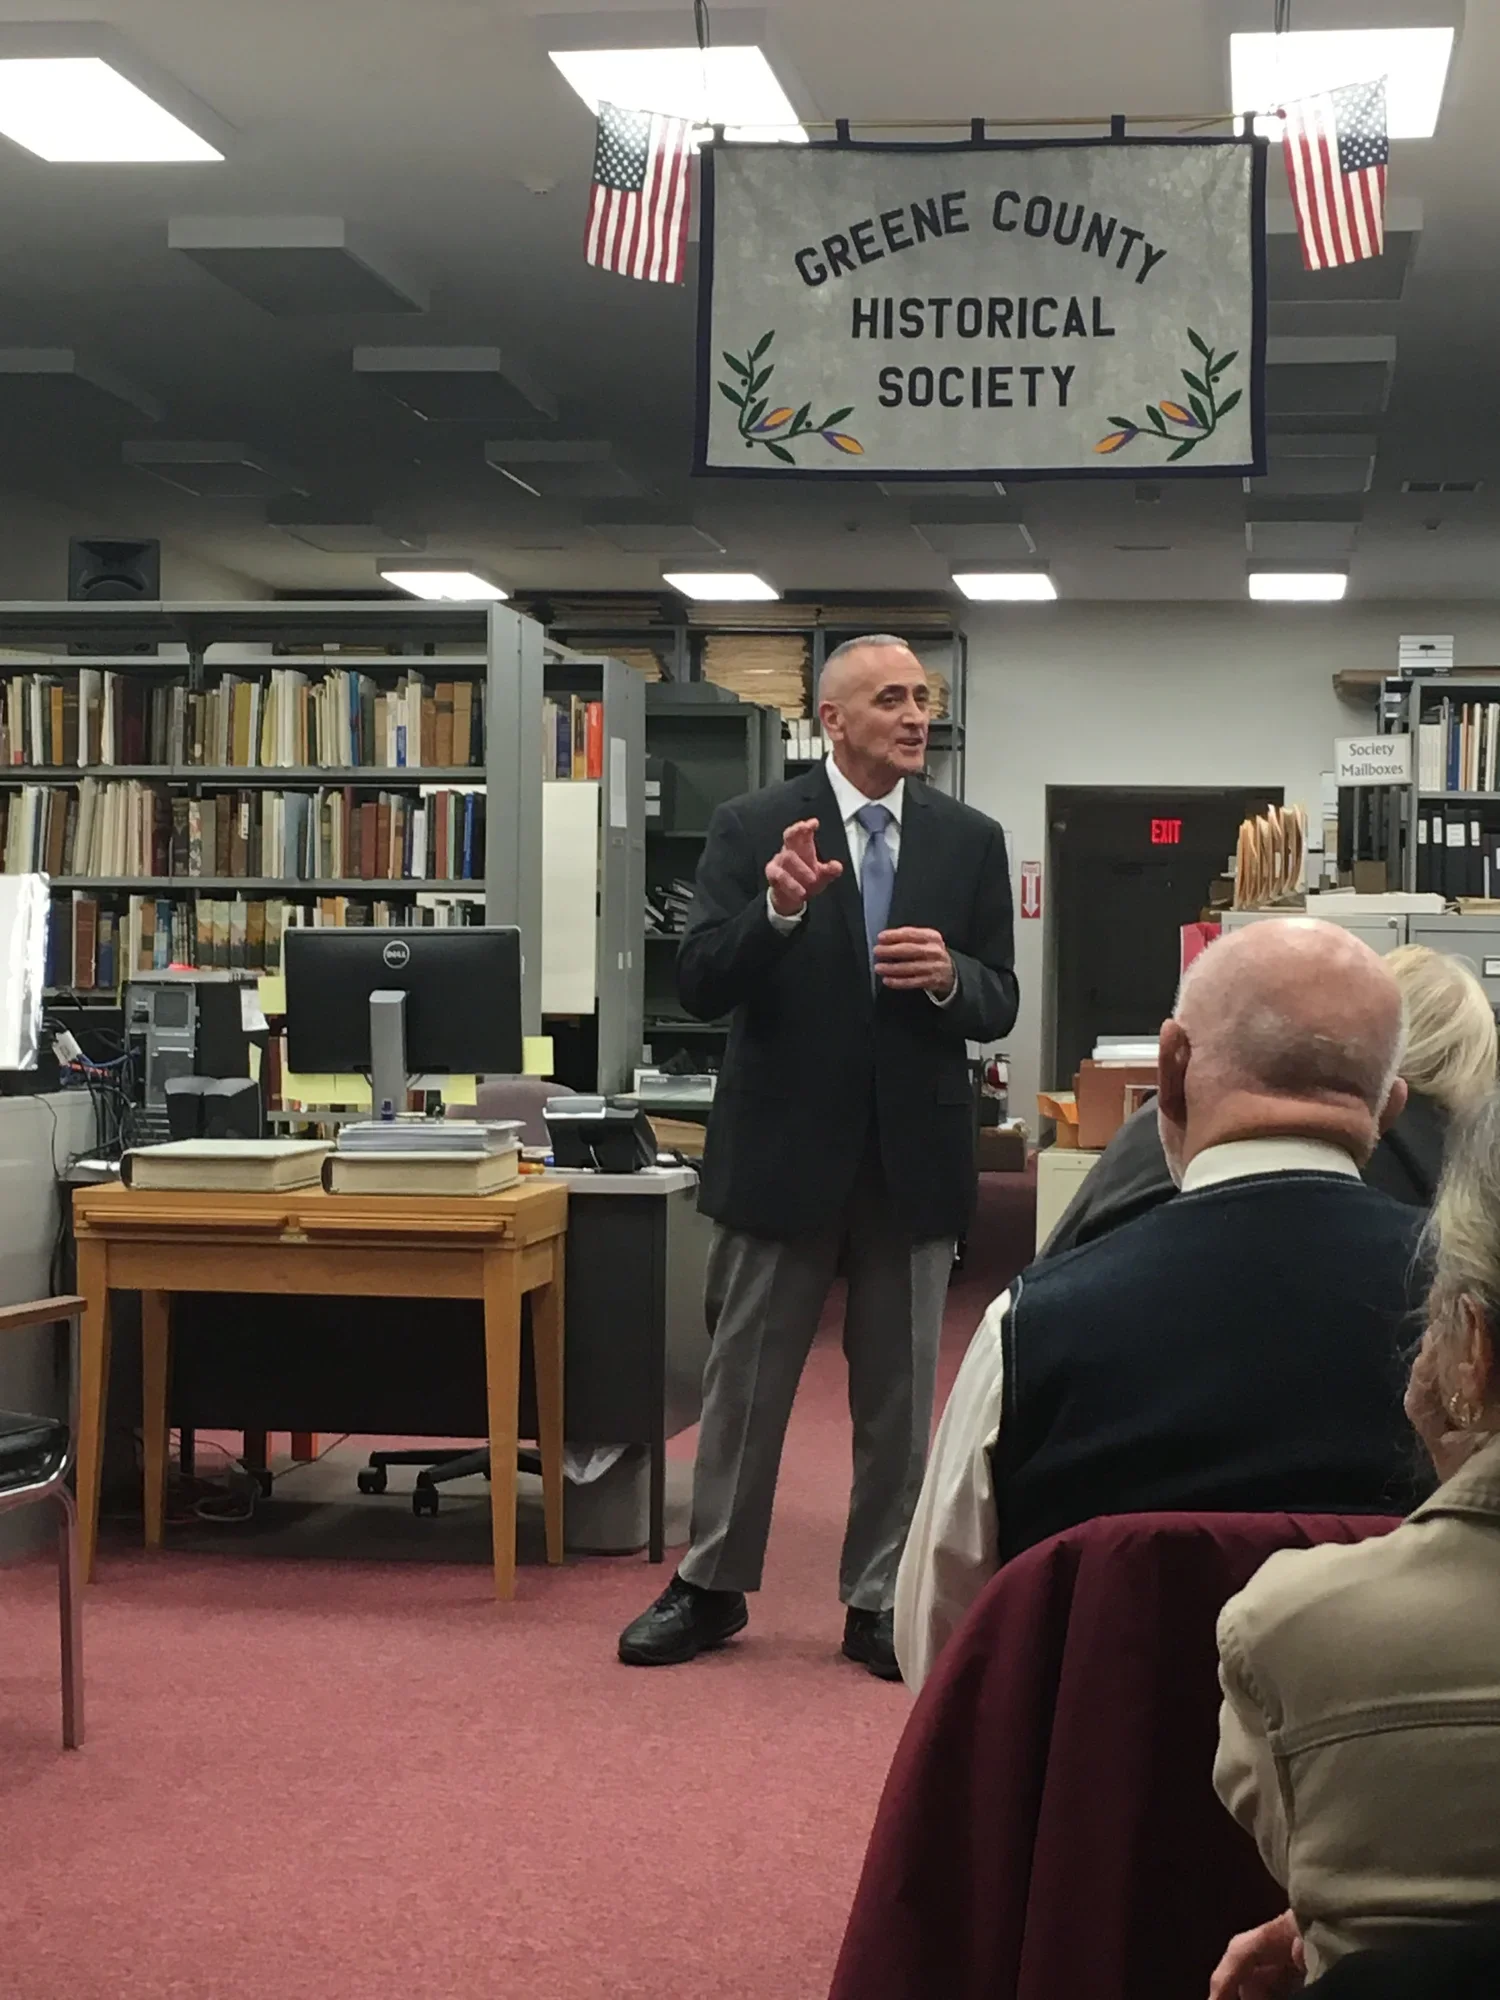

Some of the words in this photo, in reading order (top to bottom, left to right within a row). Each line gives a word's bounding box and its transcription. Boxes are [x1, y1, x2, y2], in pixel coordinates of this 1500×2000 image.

[795, 190, 969, 287] GREENE
[992, 190, 1167, 284] COUNTY
[852, 296, 1116, 339] HISTORICAL
[878, 365, 1076, 408] SOCIETY
[1349, 743, 1394, 757] Society
[1341, 763, 1404, 777] Mailboxes
[1151, 819, 1182, 844] EXIT
[386, 950, 407, 959] DELL
